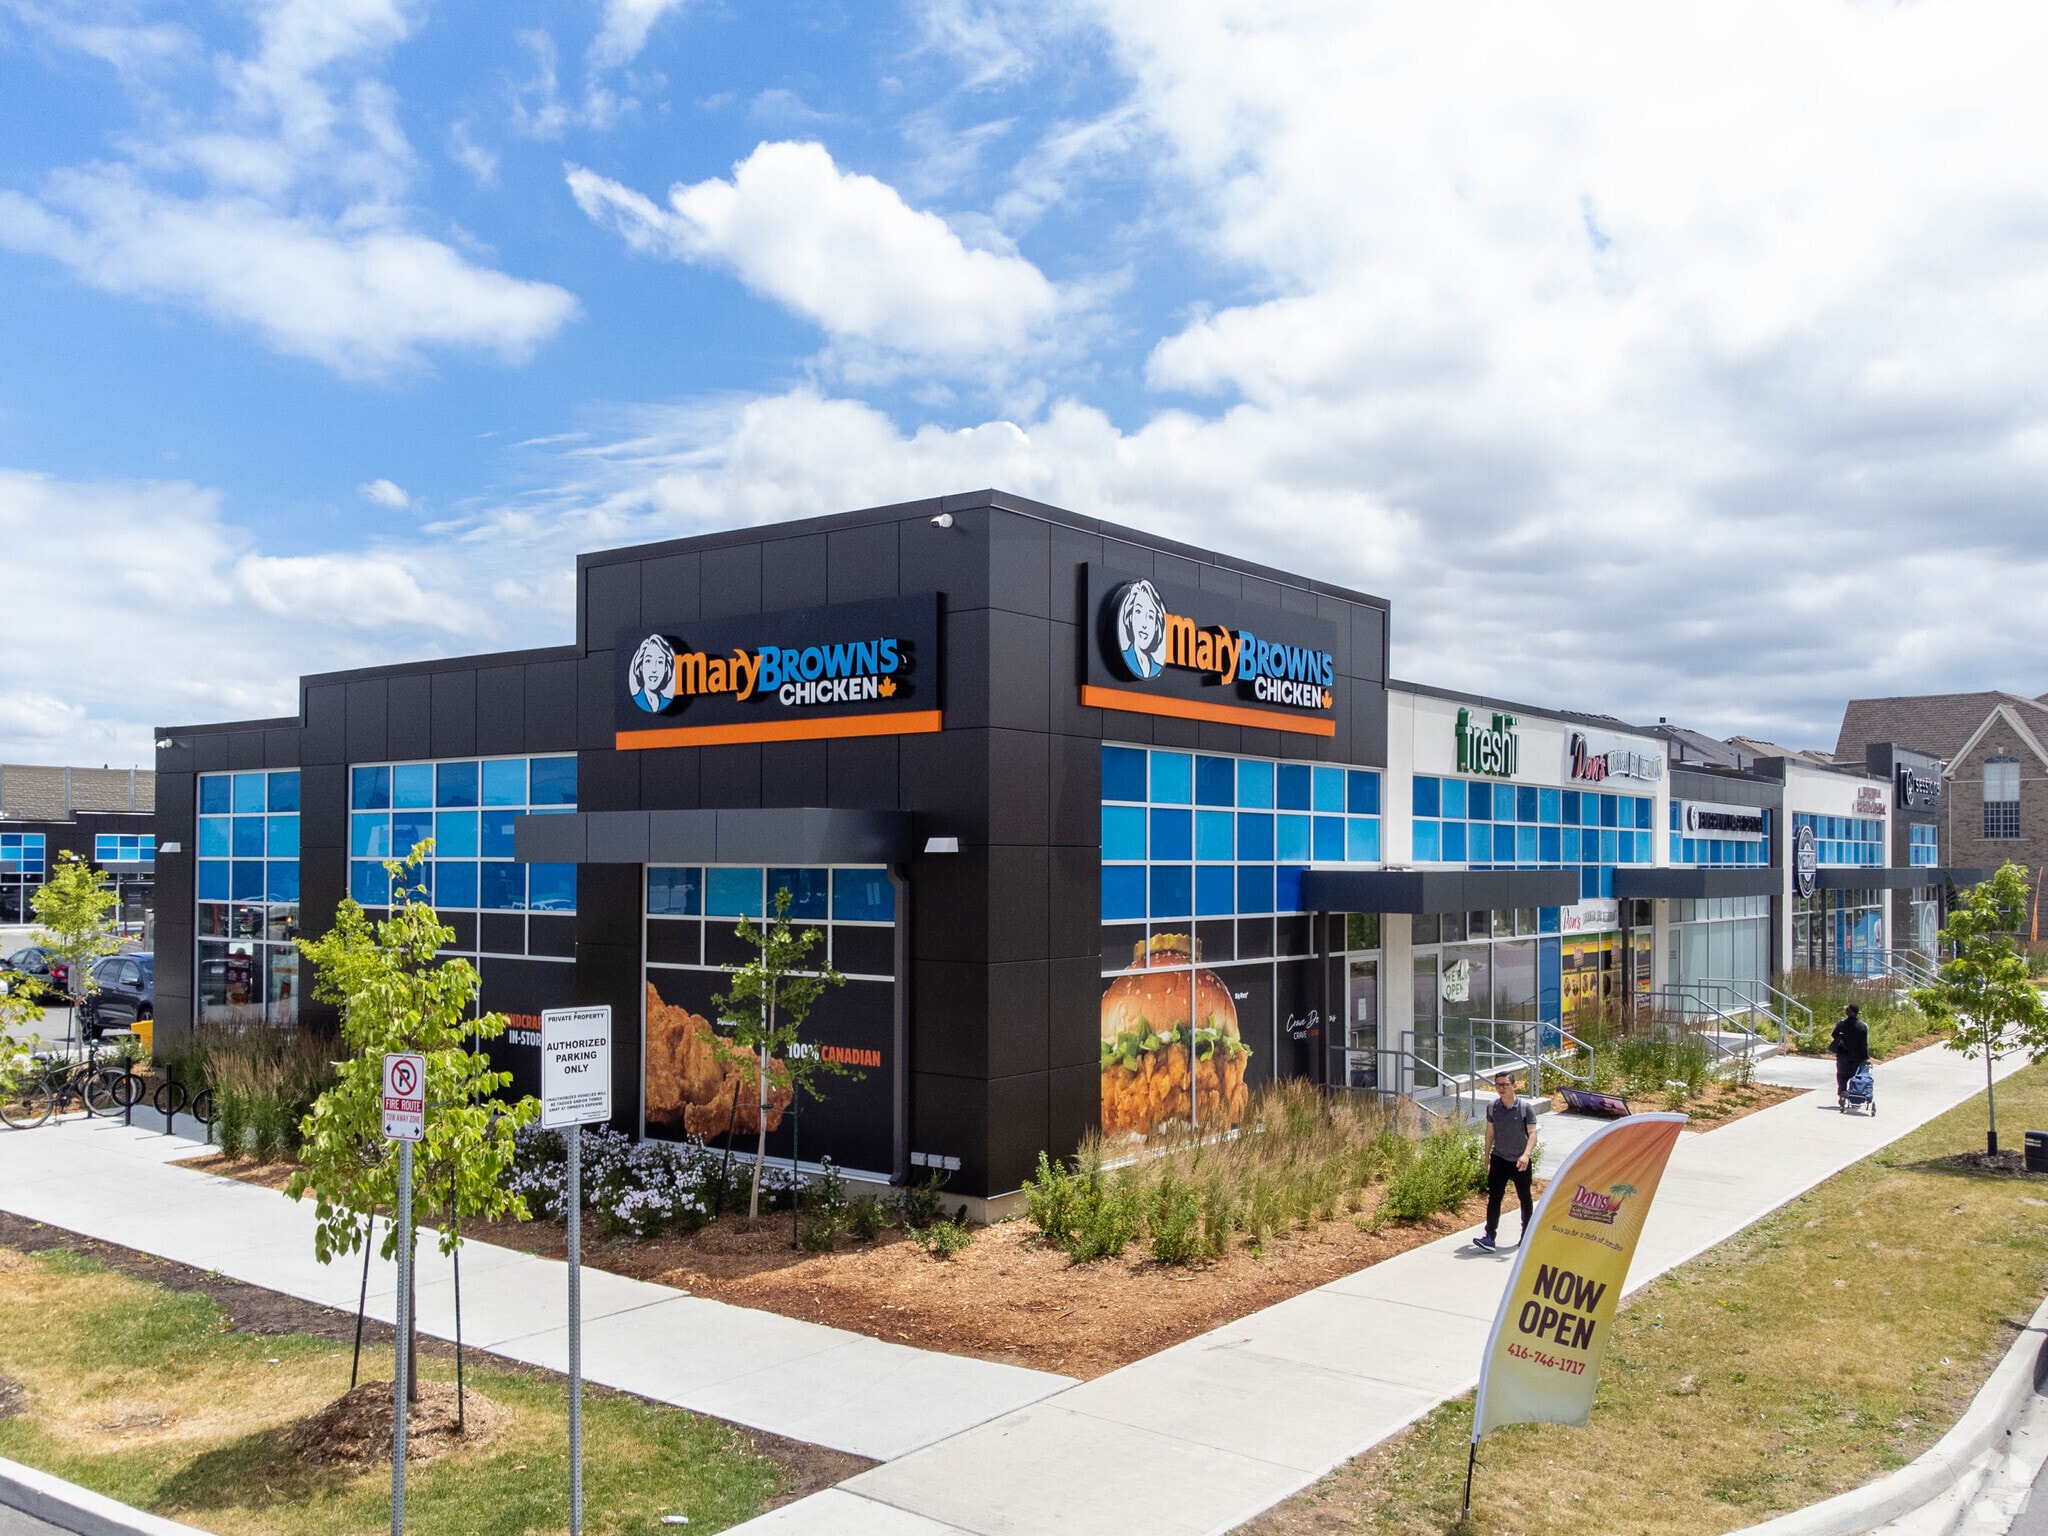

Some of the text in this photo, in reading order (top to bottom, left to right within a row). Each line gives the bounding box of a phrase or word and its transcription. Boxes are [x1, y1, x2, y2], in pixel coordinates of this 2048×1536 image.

[779, 676, 878, 706] CHICKEN
[1255, 676, 1322, 708] CHICKEN
[573, 1013, 604, 1021] PROPERTY
[547, 1038, 606, 1051] AUTHORIZED
[556, 1051, 597, 1062] PARKING
[821, 1045, 881, 1067] CANADIAN
[564, 1064, 589, 1074] ONLY
[386, 1099, 421, 1112] FIRE ROUTE
[1532, 1264, 1607, 1313] NOW
[1518, 1300, 1596, 1350] OPEN
[1507, 1343, 1586, 1376] 416-746-1717
